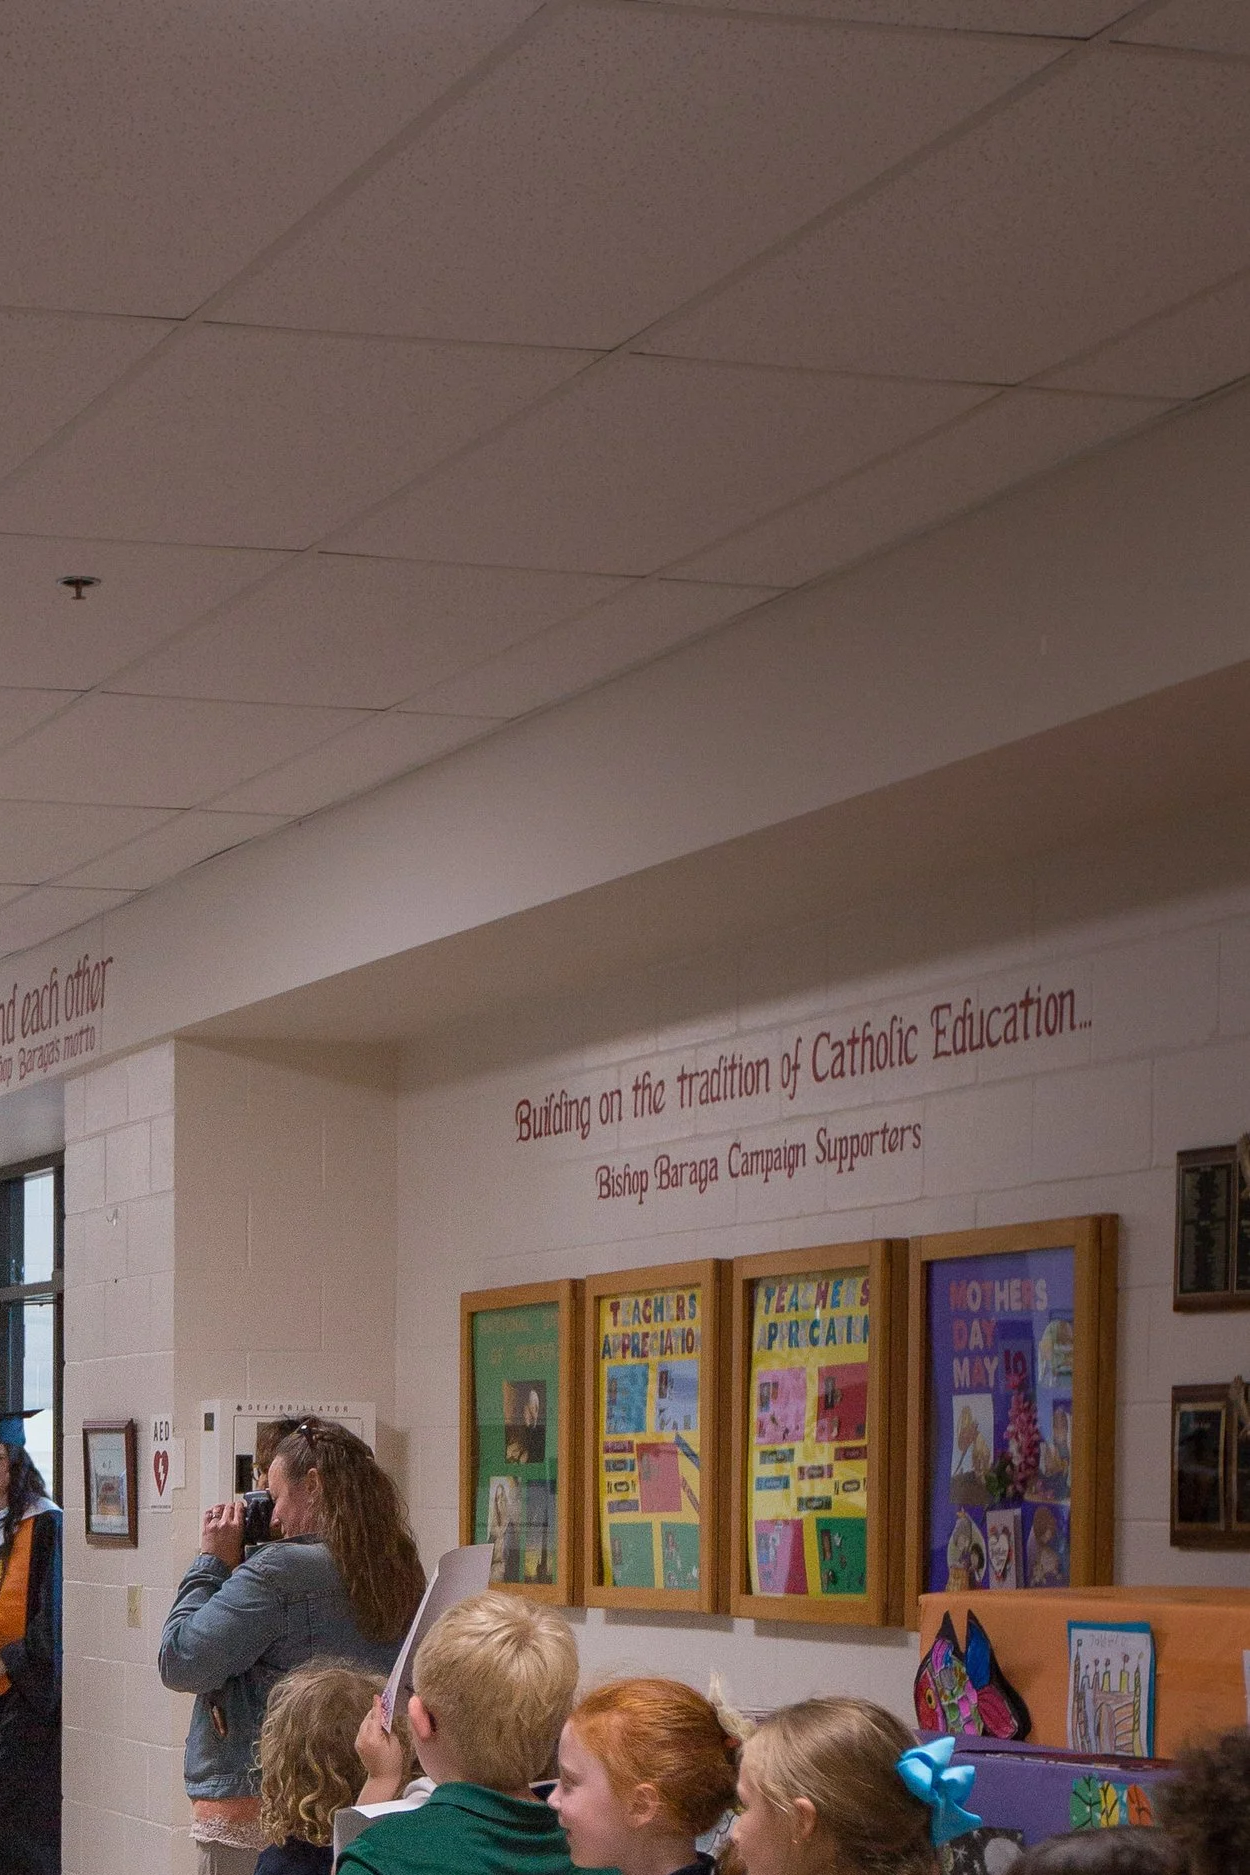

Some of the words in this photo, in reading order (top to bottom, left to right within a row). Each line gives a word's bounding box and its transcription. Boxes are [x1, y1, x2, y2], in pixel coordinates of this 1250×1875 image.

[21, 967, 59, 1039] each
[65, 954, 114, 1022] other
[63, 1024, 96, 1061] motto
[515, 1089, 592, 1142] Building
[599, 1088, 623, 1125] on
[631, 1070, 666, 1118] the
[676, 1053, 771, 1109] tradition
[781, 1036, 803, 1100] of
[812, 1015, 918, 1083] Catholic
[595, 1163, 649, 1205] Bishop
[653, 1154, 718, 1194] Baraga
[728, 1140, 807, 1183] Campaign
[815, 1122, 922, 1174] Supporters
[610, 1293, 697, 1327] TEACHERS
[764, 1279, 870, 1315] TEACHERS
[949, 1279, 1048, 1312] MOTHERS
[953, 1317, 997, 1352] DAY
[953, 1356, 999, 1389] MAY
[153, 1421, 170, 1442] AED
